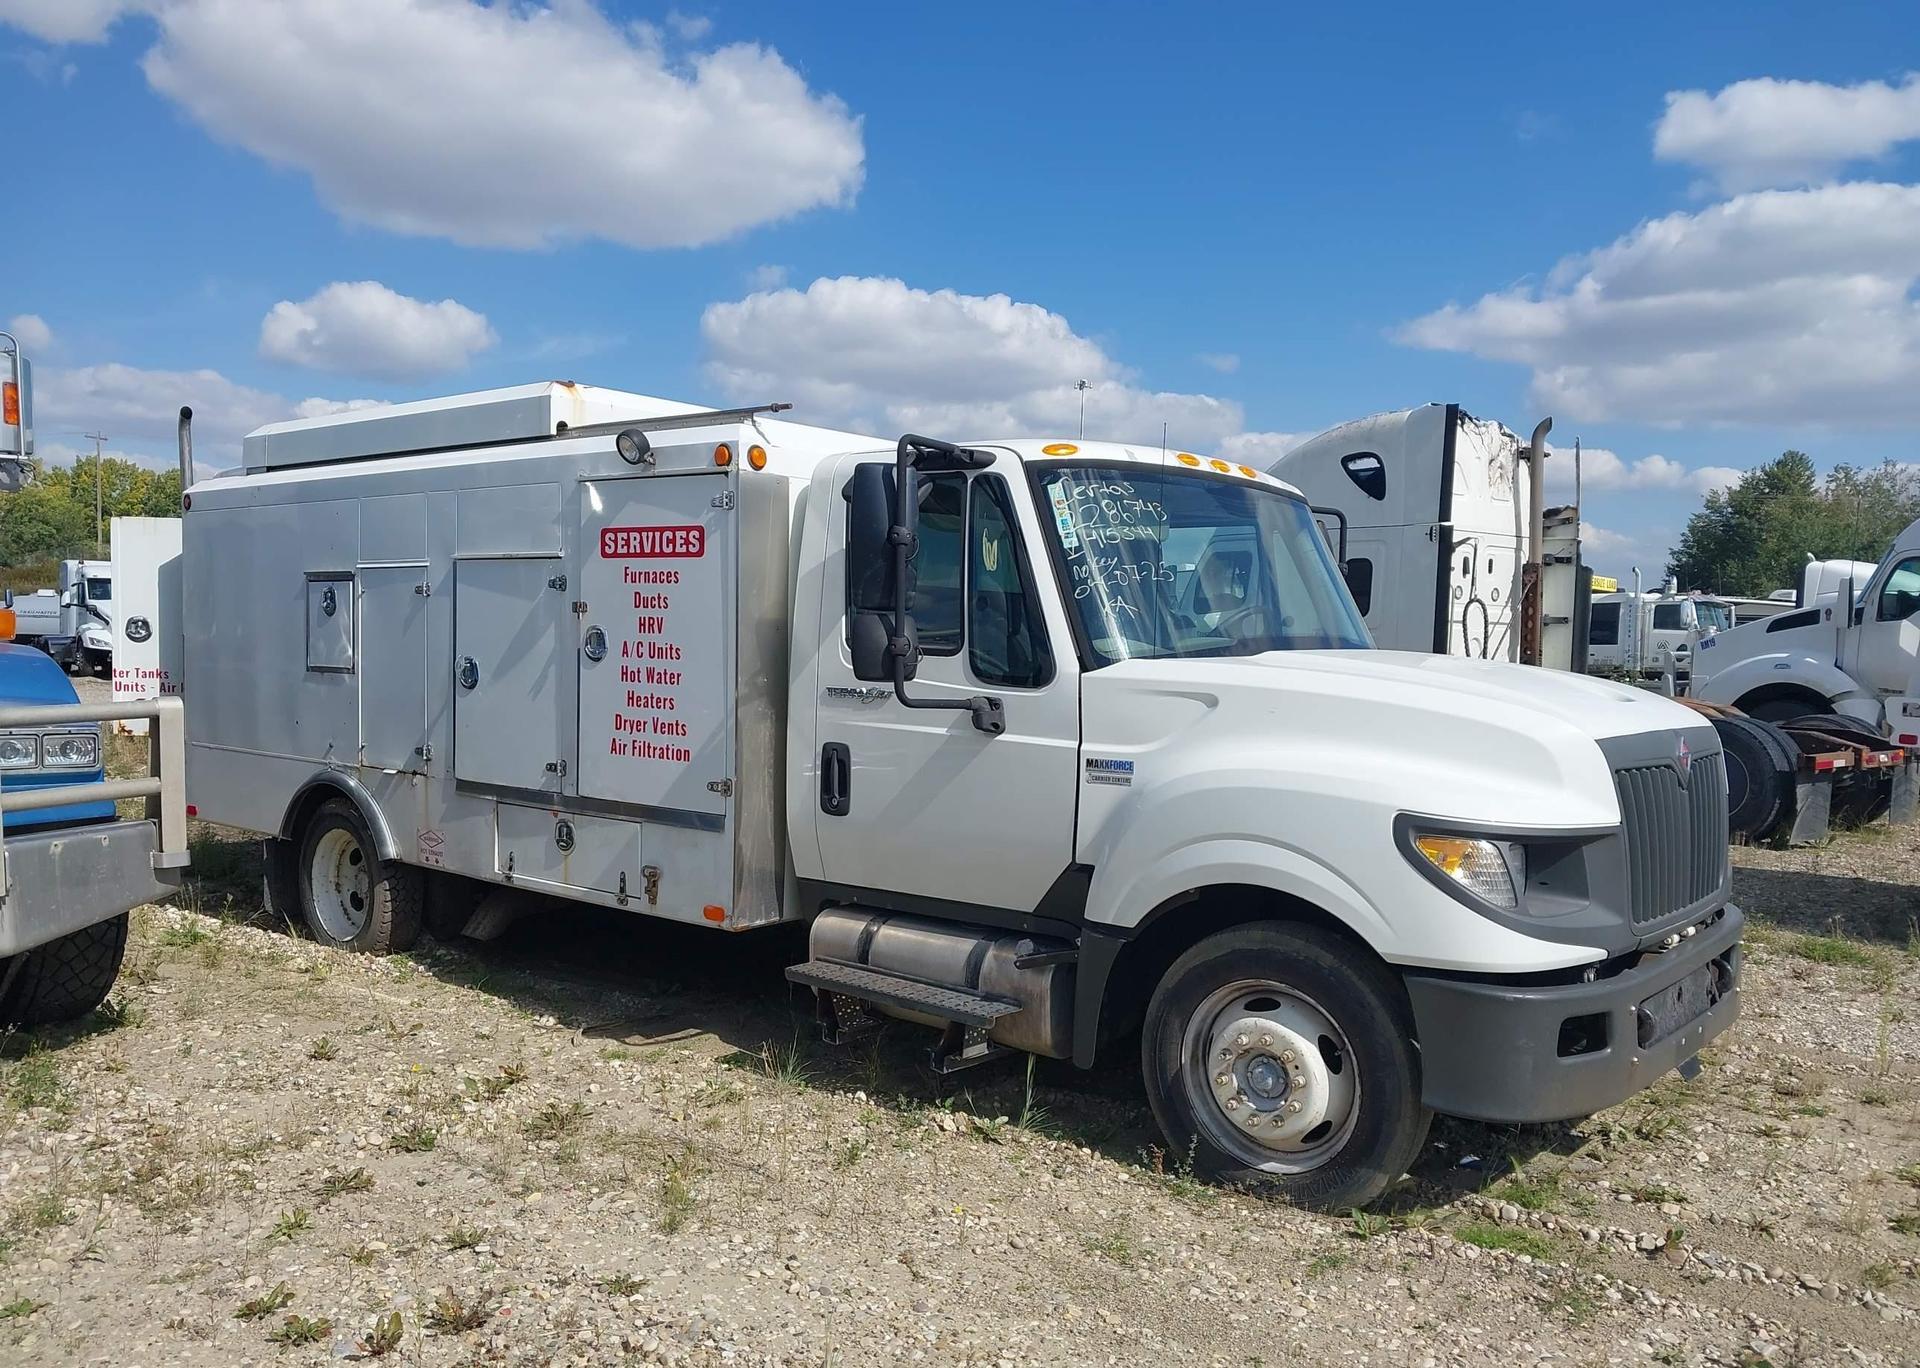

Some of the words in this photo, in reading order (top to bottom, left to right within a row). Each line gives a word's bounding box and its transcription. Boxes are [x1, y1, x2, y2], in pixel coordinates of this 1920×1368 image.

[604, 530, 700, 554] SERVICES
[624, 566, 680, 585] Furnaces
[634, 591, 669, 609] Ducts
[638, 616, 664, 634] HRV
[621, 640, 644, 659] A/C
[648, 641, 681, 660] Units
[134, 667, 170, 679] Tanks
[620, 665, 642, 683] Hot
[645, 666, 682, 685] Water
[114, 681, 146, 693] Units
[160, 682, 177, 693] Air
[627, 689, 675, 711] Heaters
[614, 713, 648, 735] Dryer
[651, 716, 687, 737] Vents
[610, 737, 628, 756] Air
[631, 739, 691, 762] Filtration
[1086, 758, 1134, 771] MAXXFORCE
